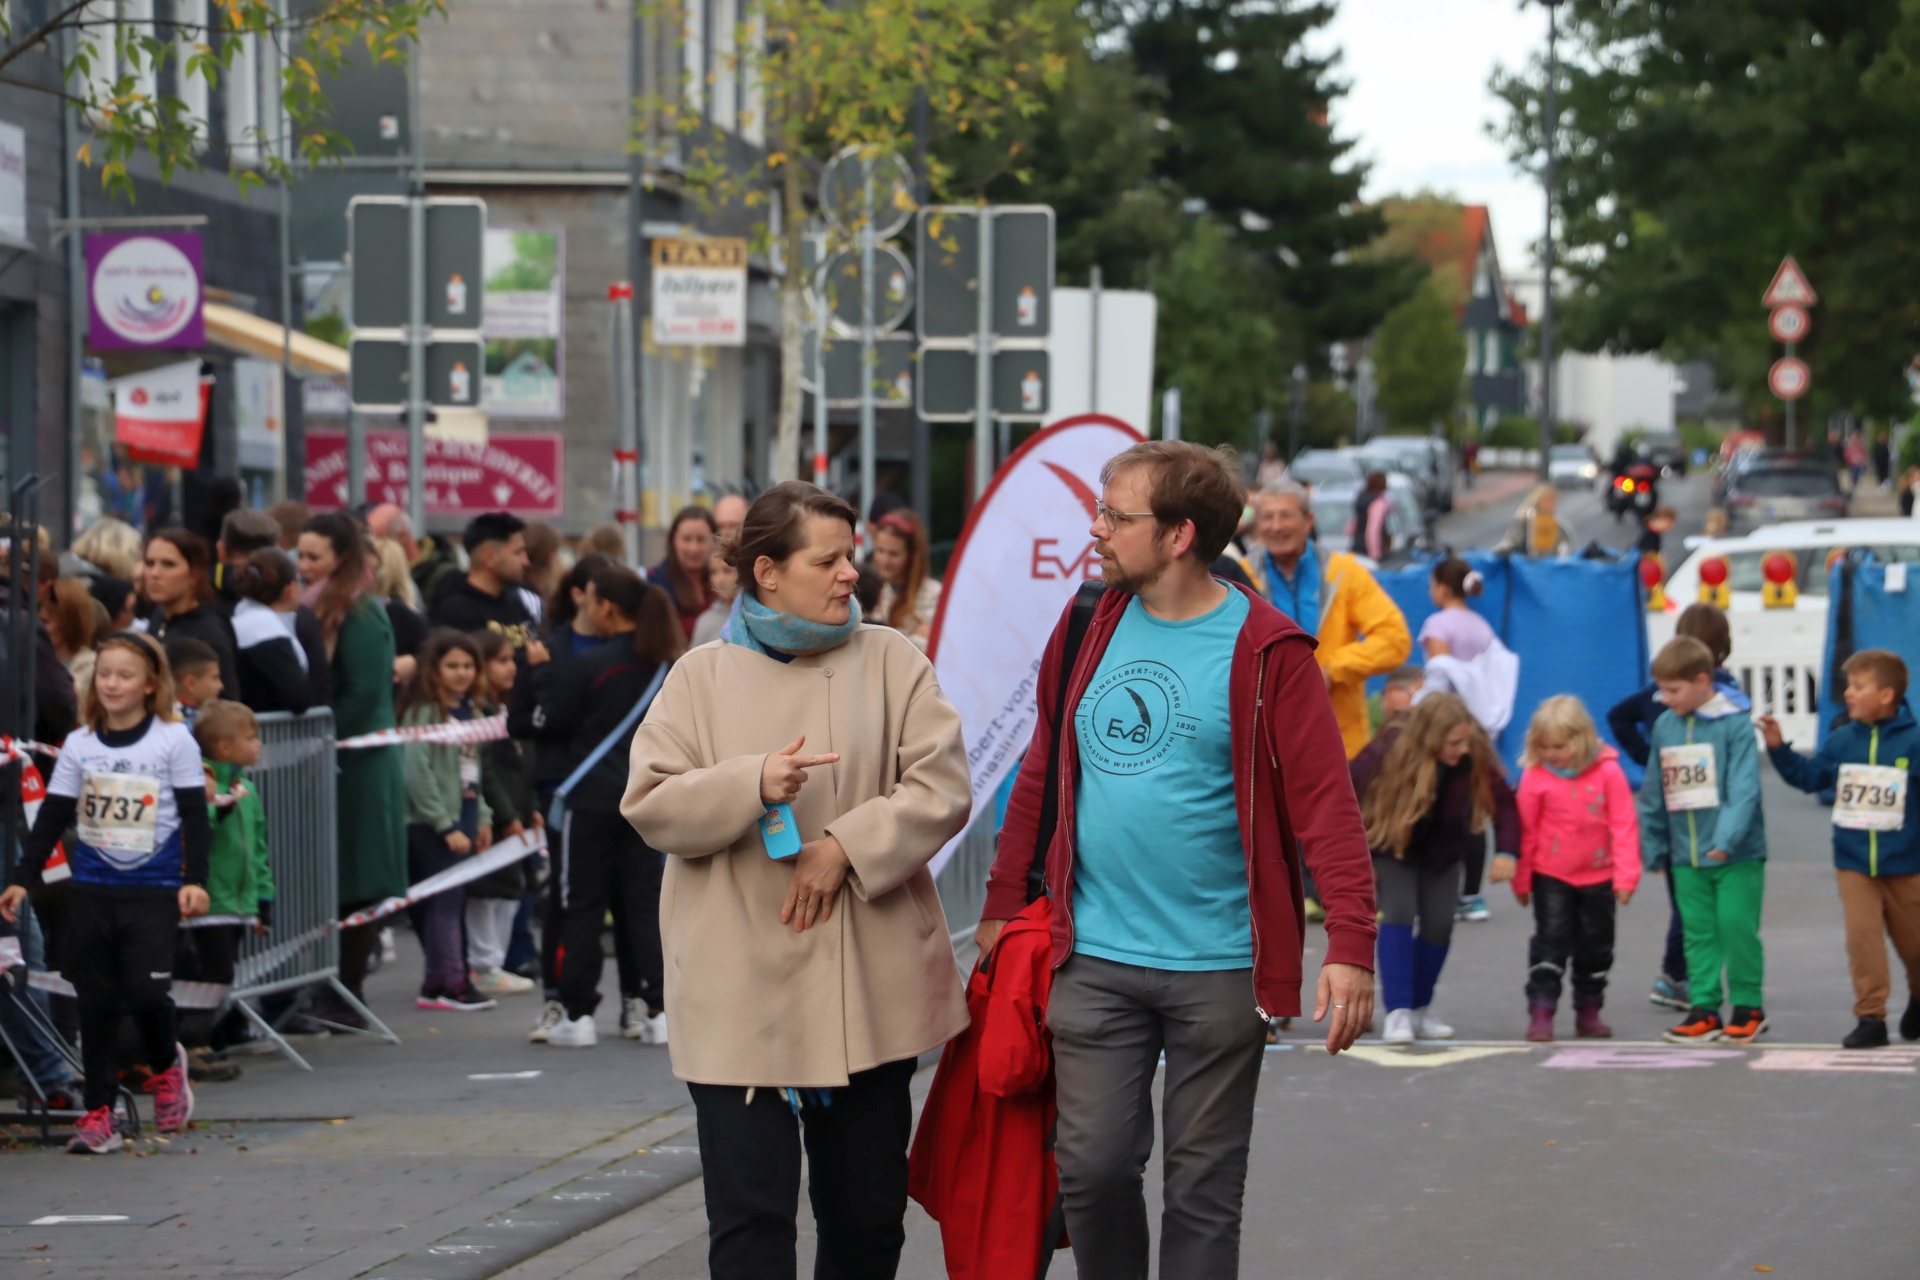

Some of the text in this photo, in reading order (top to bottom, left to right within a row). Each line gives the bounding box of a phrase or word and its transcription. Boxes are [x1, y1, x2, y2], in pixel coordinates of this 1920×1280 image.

[1093, 667, 1181, 709] ENGELBERT-VON-BERG
[1175, 721, 1197, 732] 1830
[1081, 719, 1175, 768] GYMNASIUM WIPPERFÜRTH
[84, 794, 147, 822] 5737
[1842, 783, 1896, 807] 5739
